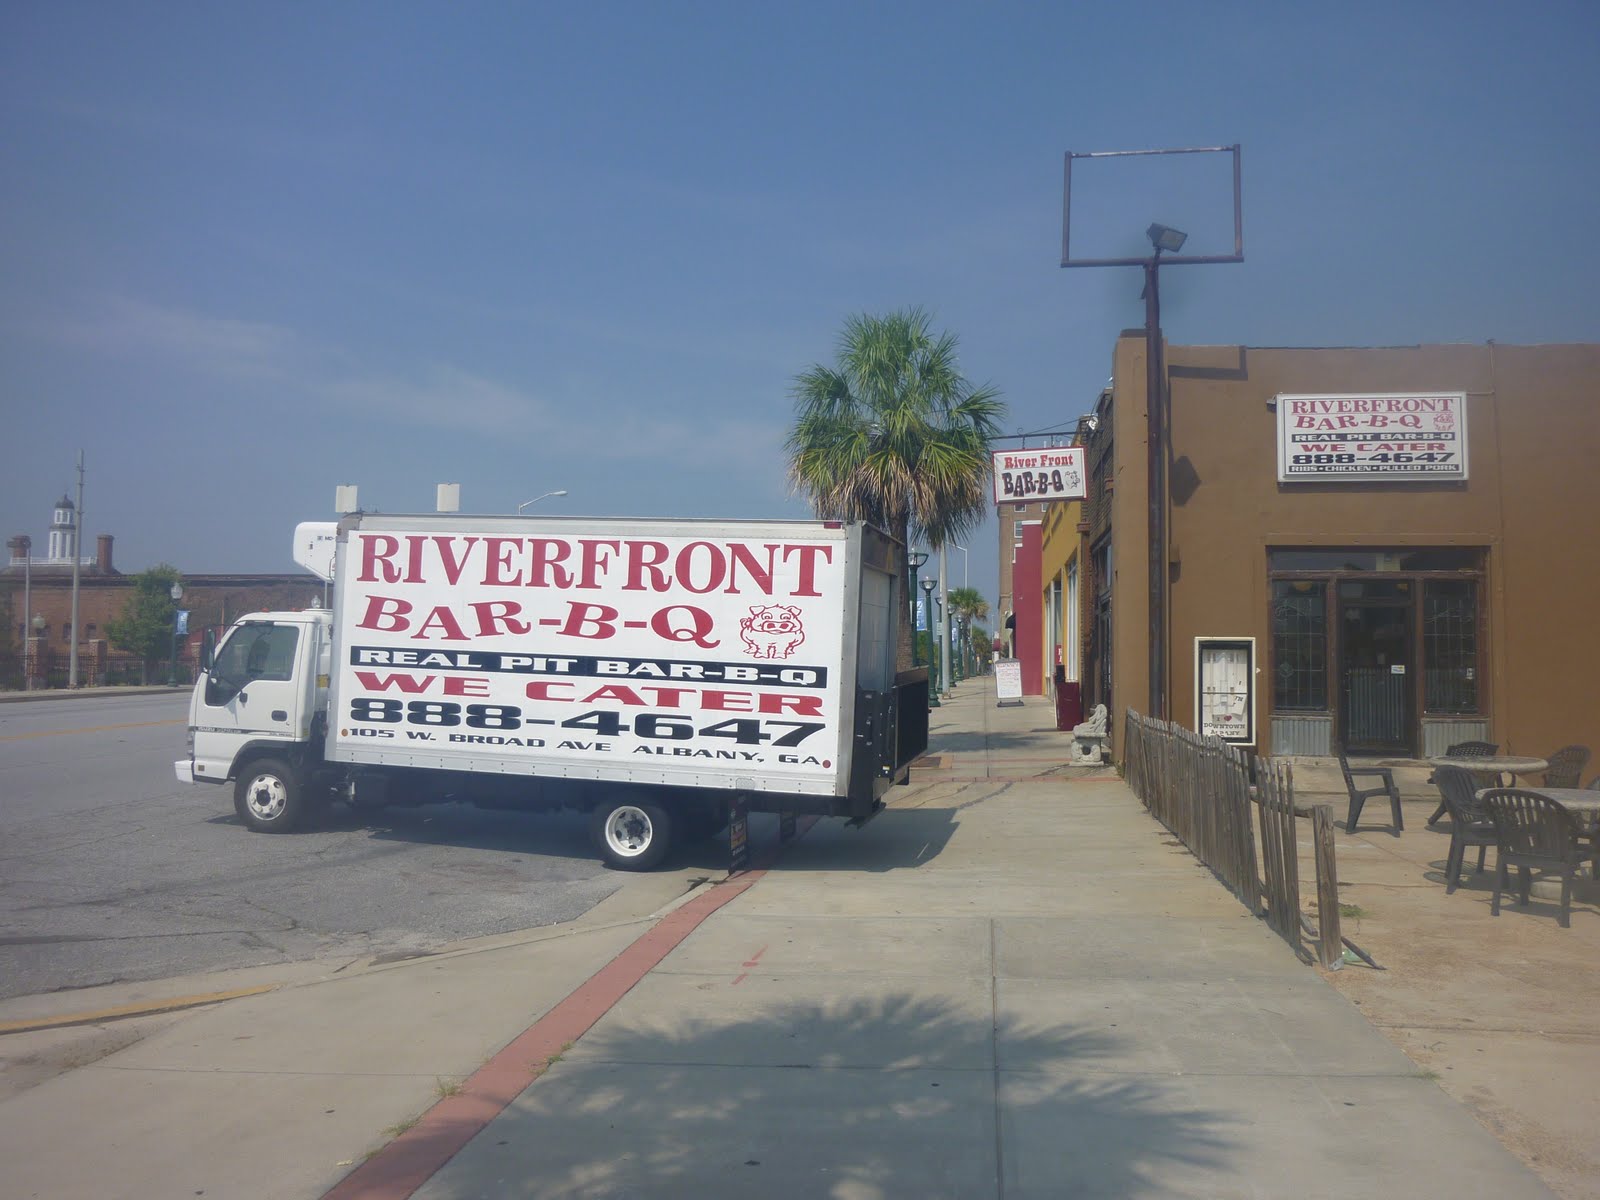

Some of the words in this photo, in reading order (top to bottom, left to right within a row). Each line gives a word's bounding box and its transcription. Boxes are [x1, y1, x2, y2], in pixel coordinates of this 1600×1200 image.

[1291, 399, 1453, 414] RIVERFRONT
[1294, 414, 1423, 431] BAR-B-Q
[1294, 434, 1341, 442] REAL
[1380, 433, 1453, 441] BAR-B-Q
[1301, 444, 1346, 452] WE
[1357, 443, 1446, 452] CATER
[1004, 456, 1037, 469] River
[1040, 453, 1073, 467] Front
[1292, 452, 1455, 465] 888-4647
[1001, 469, 1064, 497] BAR-B-Q
[356, 534, 832, 597] RIVERFRONT
[355, 595, 721, 649] BAR-B-Q
[359, 650, 482, 668] REAL
[500, 656, 578, 672] PIT
[596, 660, 817, 685] BAR-B-Q
[354, 671, 491, 697] WE
[525, 681, 824, 717] CATER
[350, 697, 826, 748] 888-4647
[350, 728, 395, 738] 105
[406, 731, 436, 741] W.
[449, 734, 546, 747] BROAD
[556, 741, 611, 752] AVE
[632, 745, 765, 763] ALBANY,
